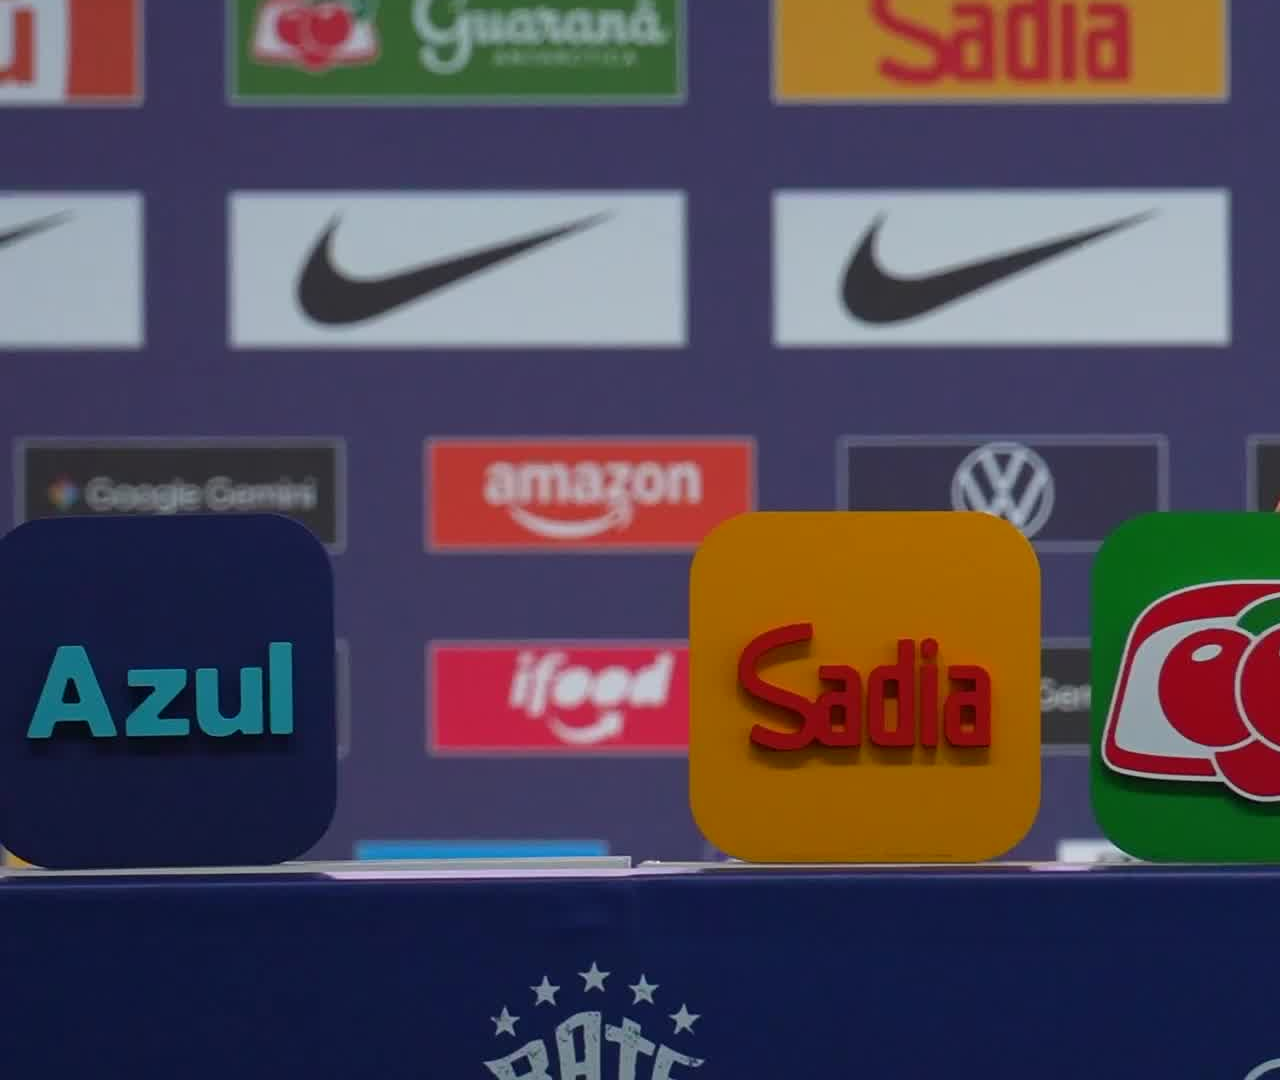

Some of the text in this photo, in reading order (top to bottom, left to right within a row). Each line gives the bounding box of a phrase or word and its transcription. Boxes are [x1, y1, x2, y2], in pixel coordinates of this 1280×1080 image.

[86, 478, 317, 512] Google Gemini
[484, 461, 701, 505] amazon
[26, 642, 294, 738] Azul
[512, 654, 673, 718] ifood
[737, 622, 992, 751] Sadia
